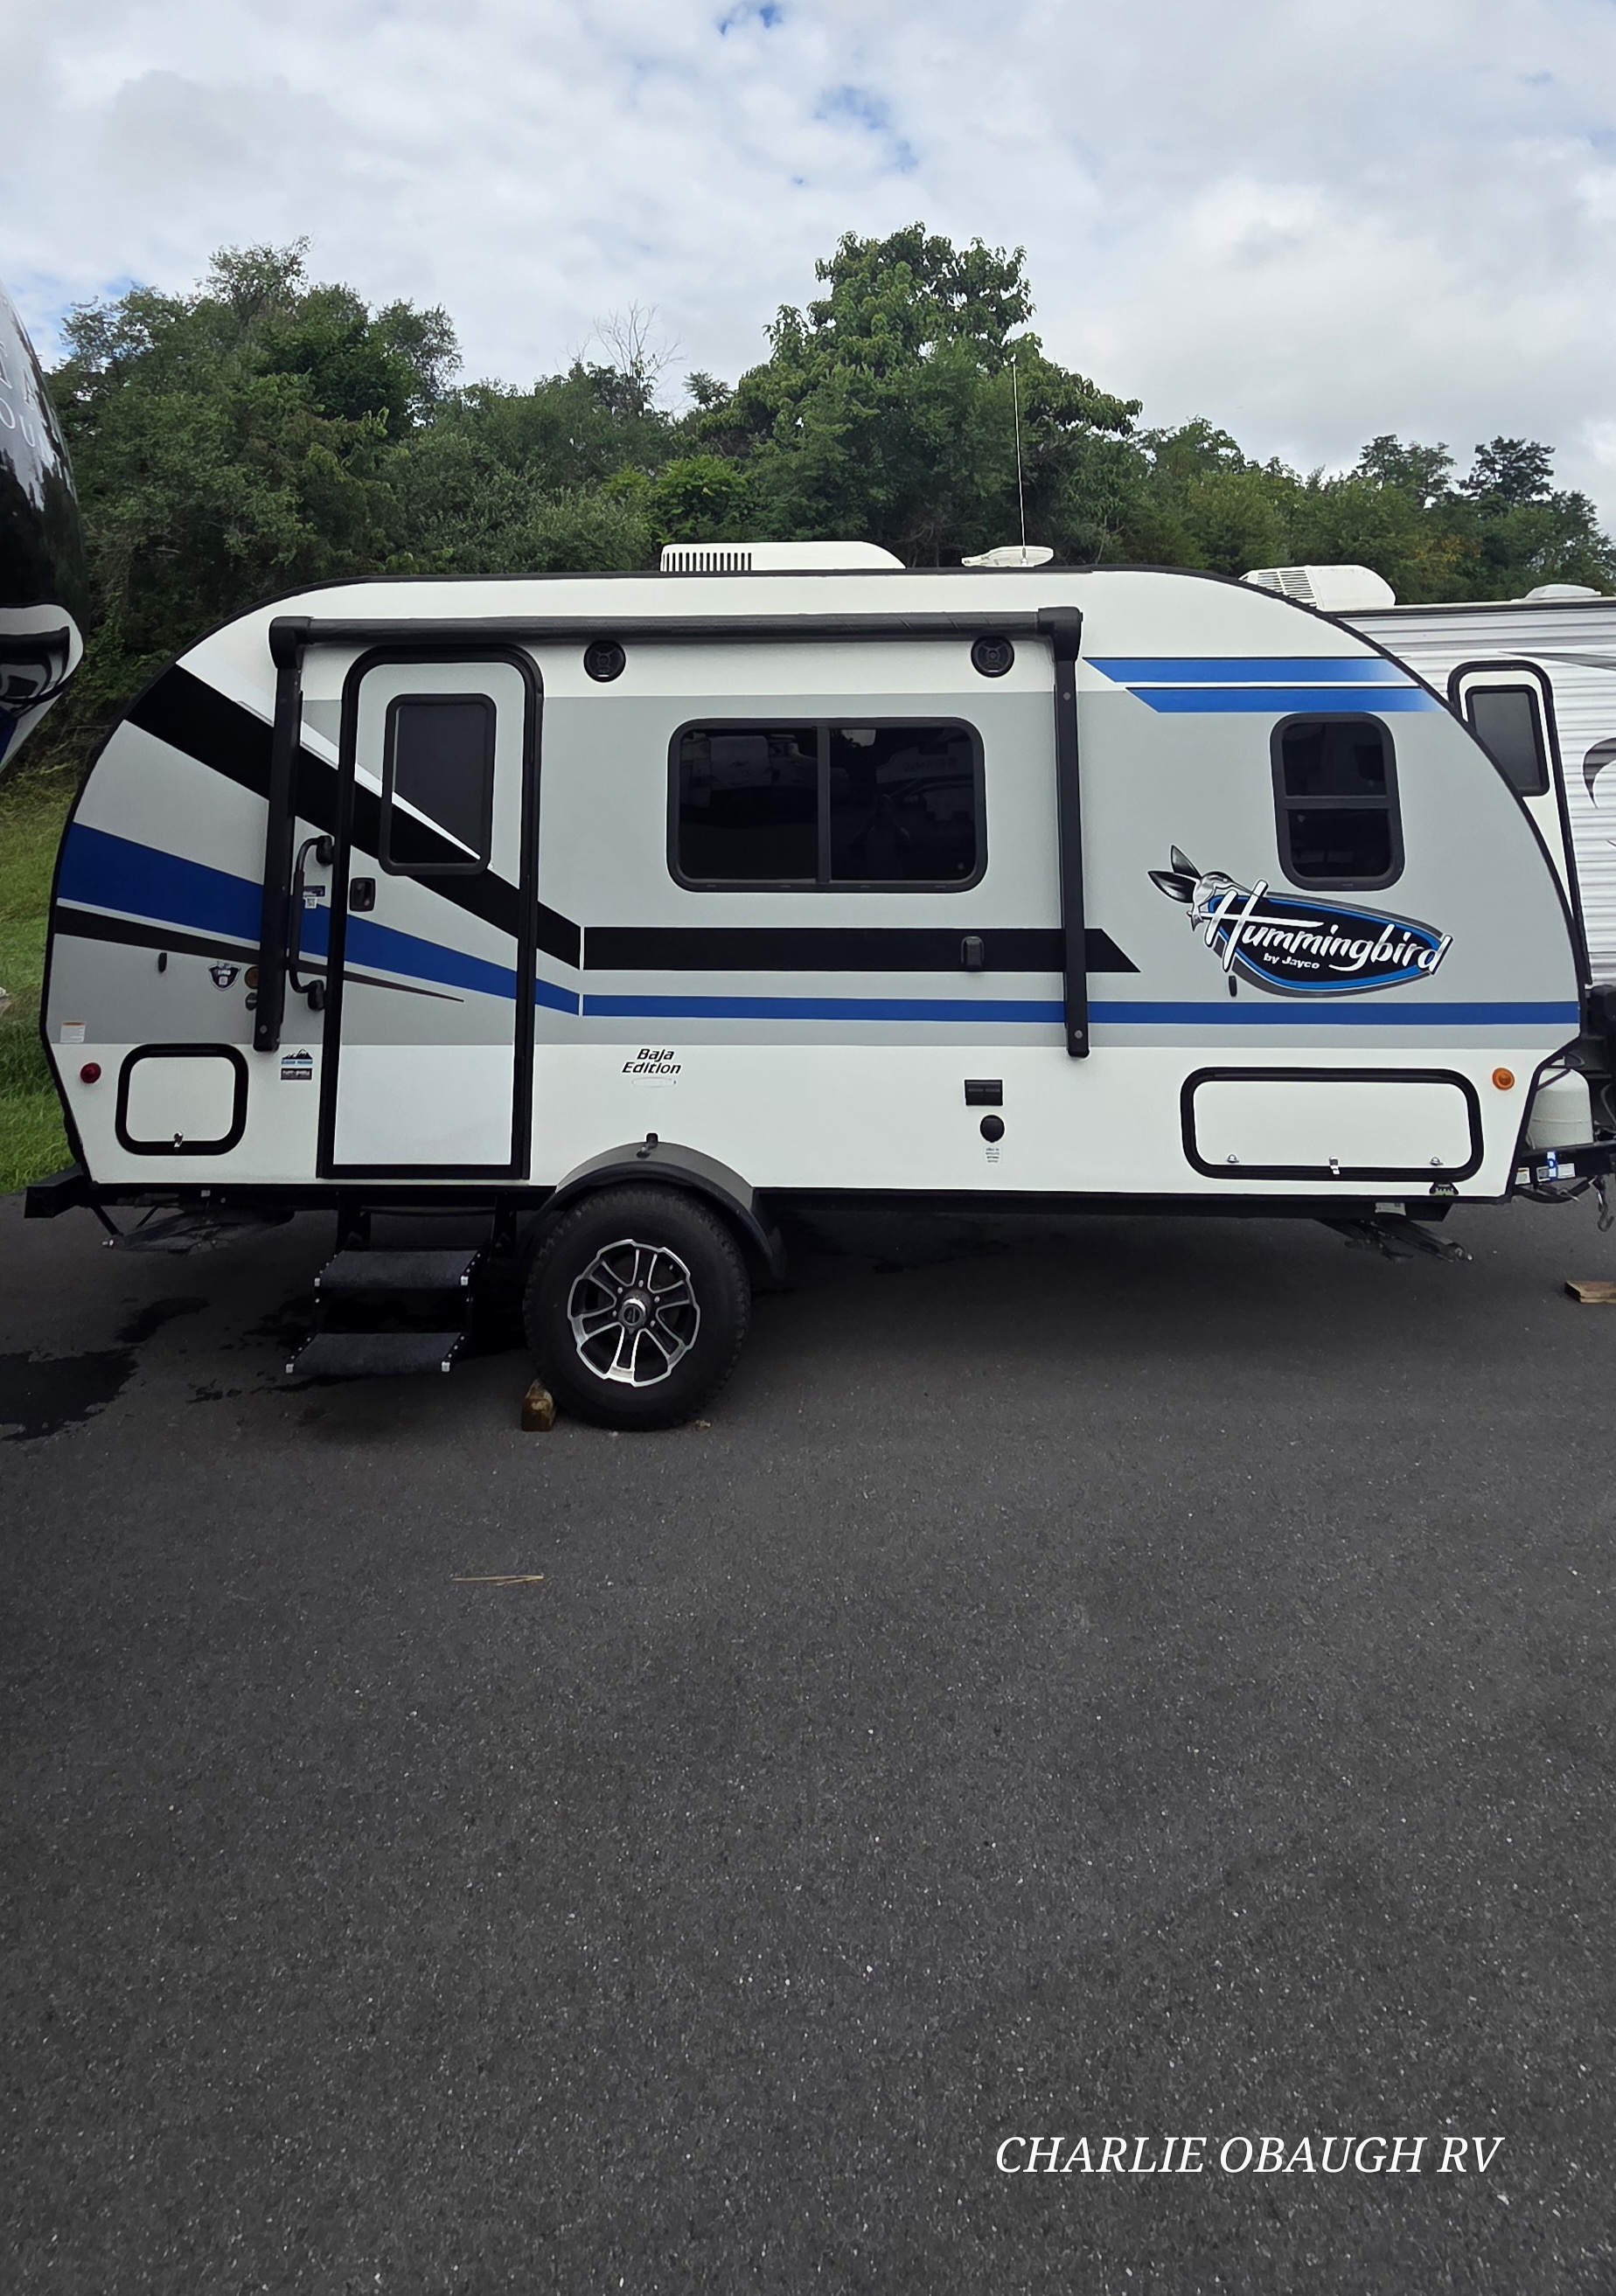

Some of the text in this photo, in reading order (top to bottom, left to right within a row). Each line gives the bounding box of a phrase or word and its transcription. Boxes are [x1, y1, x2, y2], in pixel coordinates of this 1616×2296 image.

[1188, 880, 1452, 975] Hummingbird
[1263, 952, 1320, 970] by Jayco
[637, 1048, 674, 1062] Baja
[622, 1061, 681, 1074] Edition
